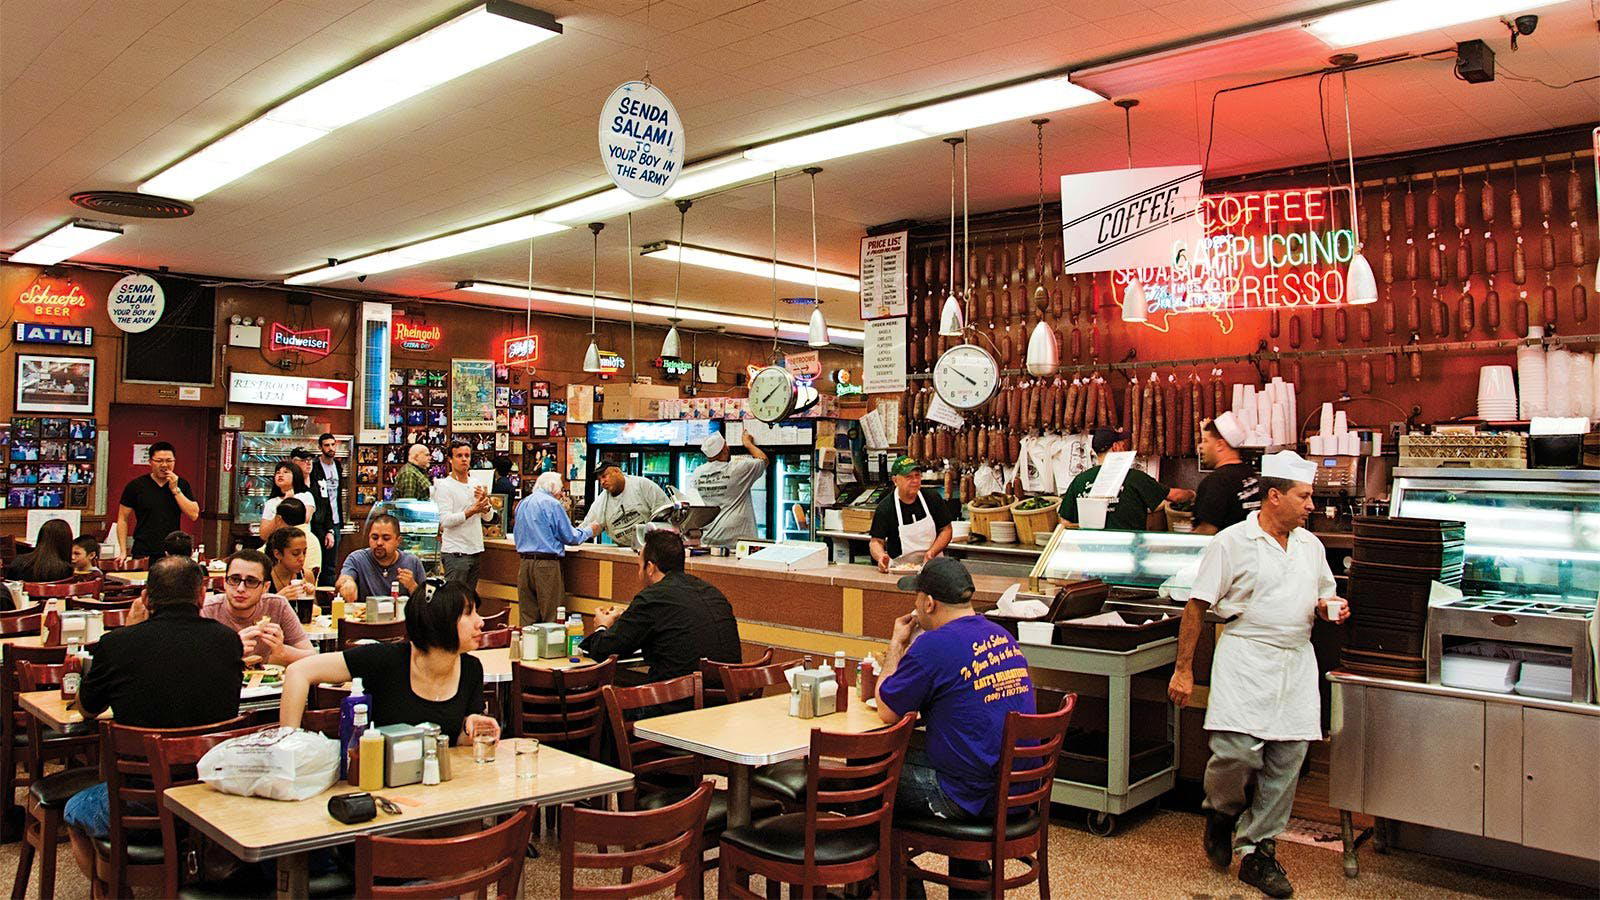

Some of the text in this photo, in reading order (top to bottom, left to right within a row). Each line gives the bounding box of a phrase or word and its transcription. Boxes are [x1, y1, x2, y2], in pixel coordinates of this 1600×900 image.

[611, 116, 674, 147] SALAMI
[636, 141, 651, 153] TO
[609, 144, 675, 172] YOUR BOY IN
[617, 164, 669, 186] THE ARMY
[1097, 186, 1180, 245] COFFEE
[1195, 190, 1325, 229] COFFEE
[867, 236, 902, 250] PRICE LIST
[19, 284, 86, 307] Schaefer
[115, 295, 155, 304] SALAMI
[35, 306, 70, 317] BEER
[113, 309, 131, 317] YOUR
[132, 316, 155, 324] ARMY
[27, 327, 83, 342] ATM
[275, 332, 329, 349] Budweiser
[394, 323, 441, 341] Rheingold
[972, 640, 988, 656] Send
[990, 635, 1008, 648] Salami
[960, 666, 972, 681] To
[971, 660, 989, 677] Your
[987, 652, 1001, 665] Boy
